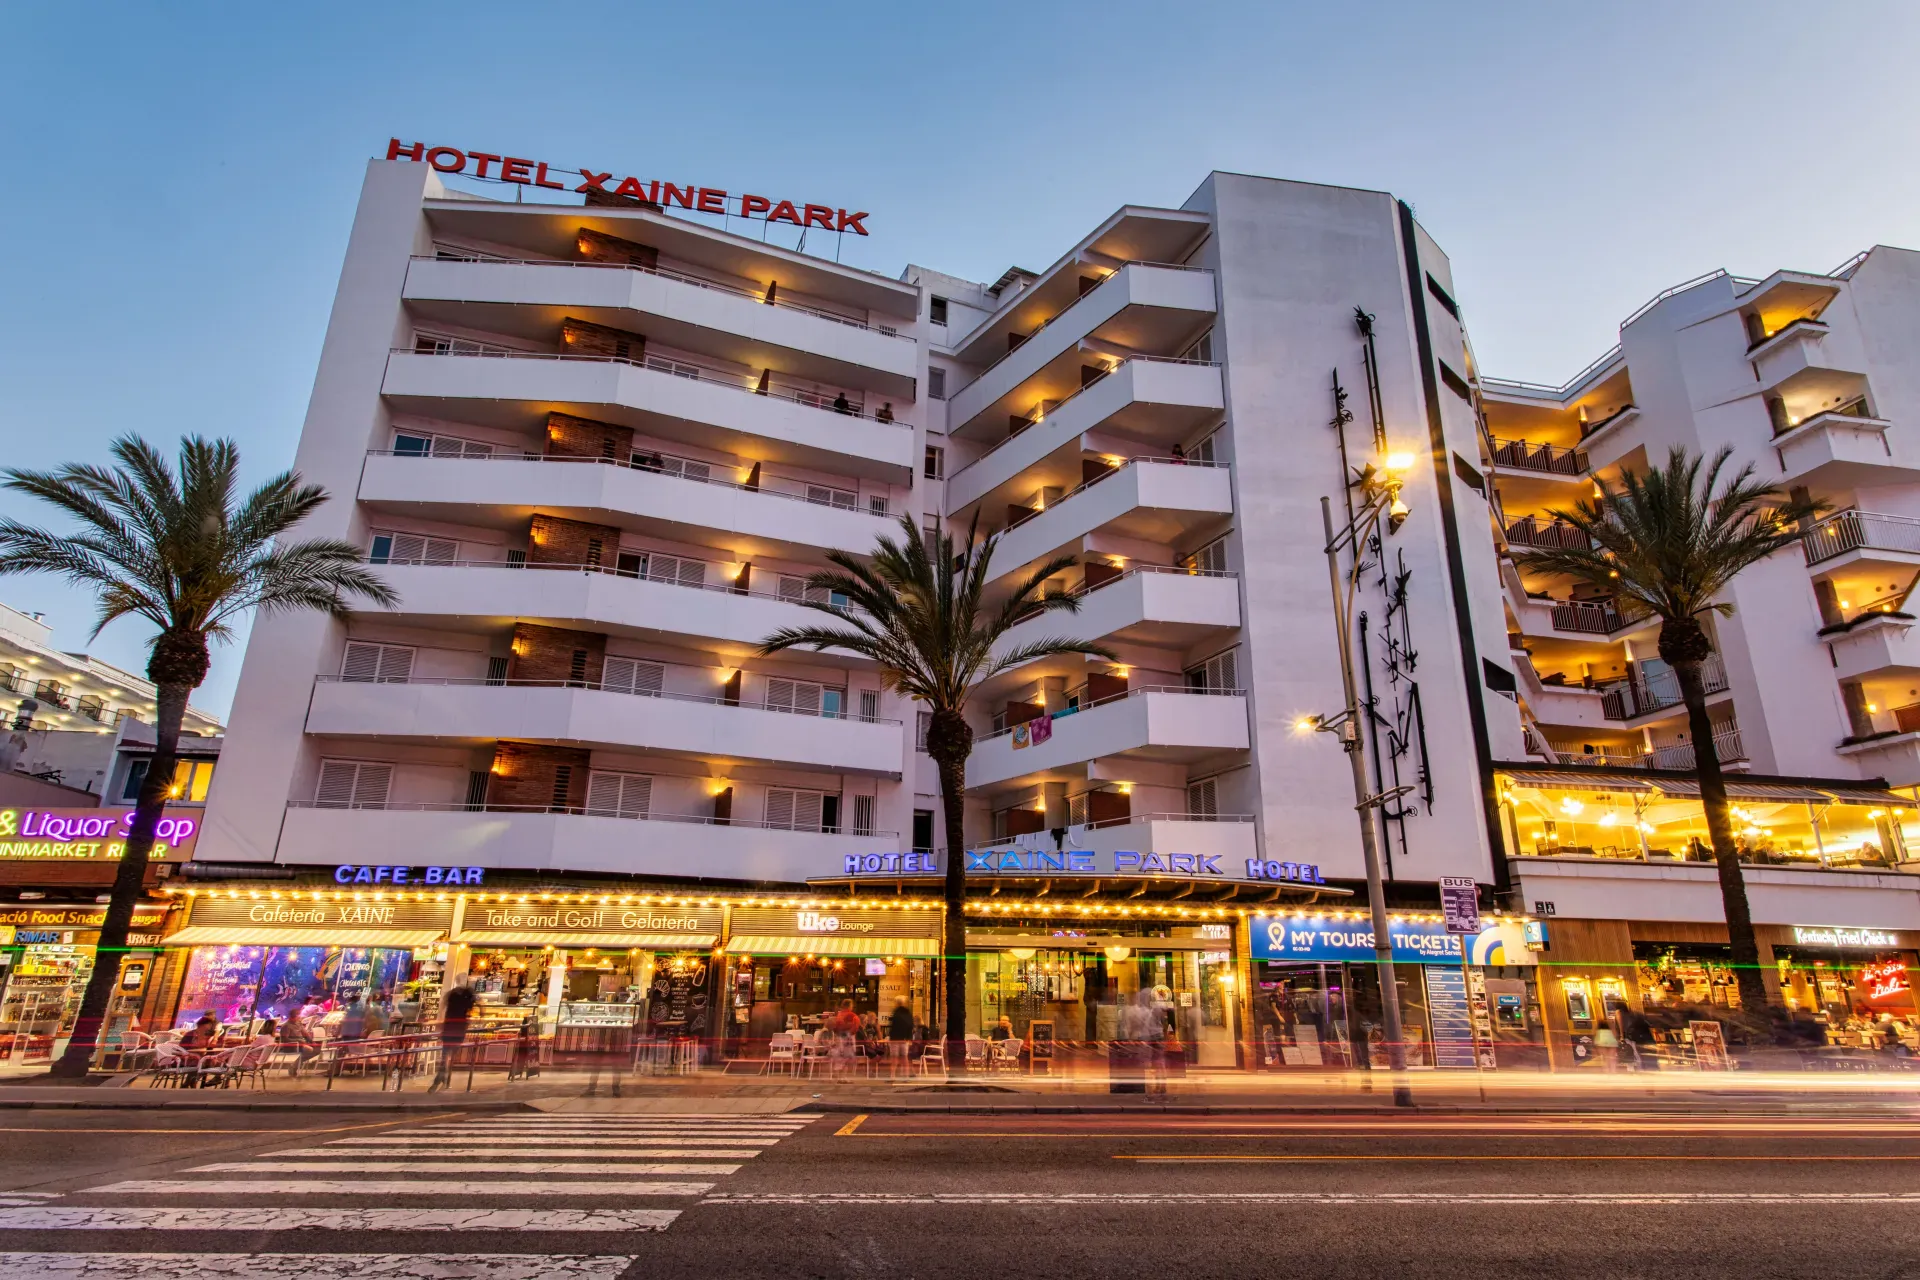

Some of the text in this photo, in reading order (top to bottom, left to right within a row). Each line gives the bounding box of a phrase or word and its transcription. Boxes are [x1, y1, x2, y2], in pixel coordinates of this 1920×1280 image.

[385, 137, 870, 237] HOTEL XAINE PARK
[119, 812, 194, 846] Sop
[0, 842, 168, 858] INIMARKET RIR
[845, 852, 937, 873] HOTEL
[966, 850, 1225, 874] XAINE PARK
[1245, 858, 1326, 884] HOTEL
[1443, 878, 1473, 887] BUS
[0, 910, 28, 923] ació
[31, 910, 66, 924] Food
[131, 914, 162, 925] ougat
[249, 904, 396, 925] Cafeteria XAINE
[485, 909, 698, 930] Take and Go!! Gelateria
[840, 921, 874, 932] Lounge
[14, 931, 60, 943] RIMAR
[127, 932, 162, 945] ARKET
[1291, 931, 1461, 950] MY TOURS TICKETS
[1794, 927, 1897, 947] Kentucky Fried Chickn
